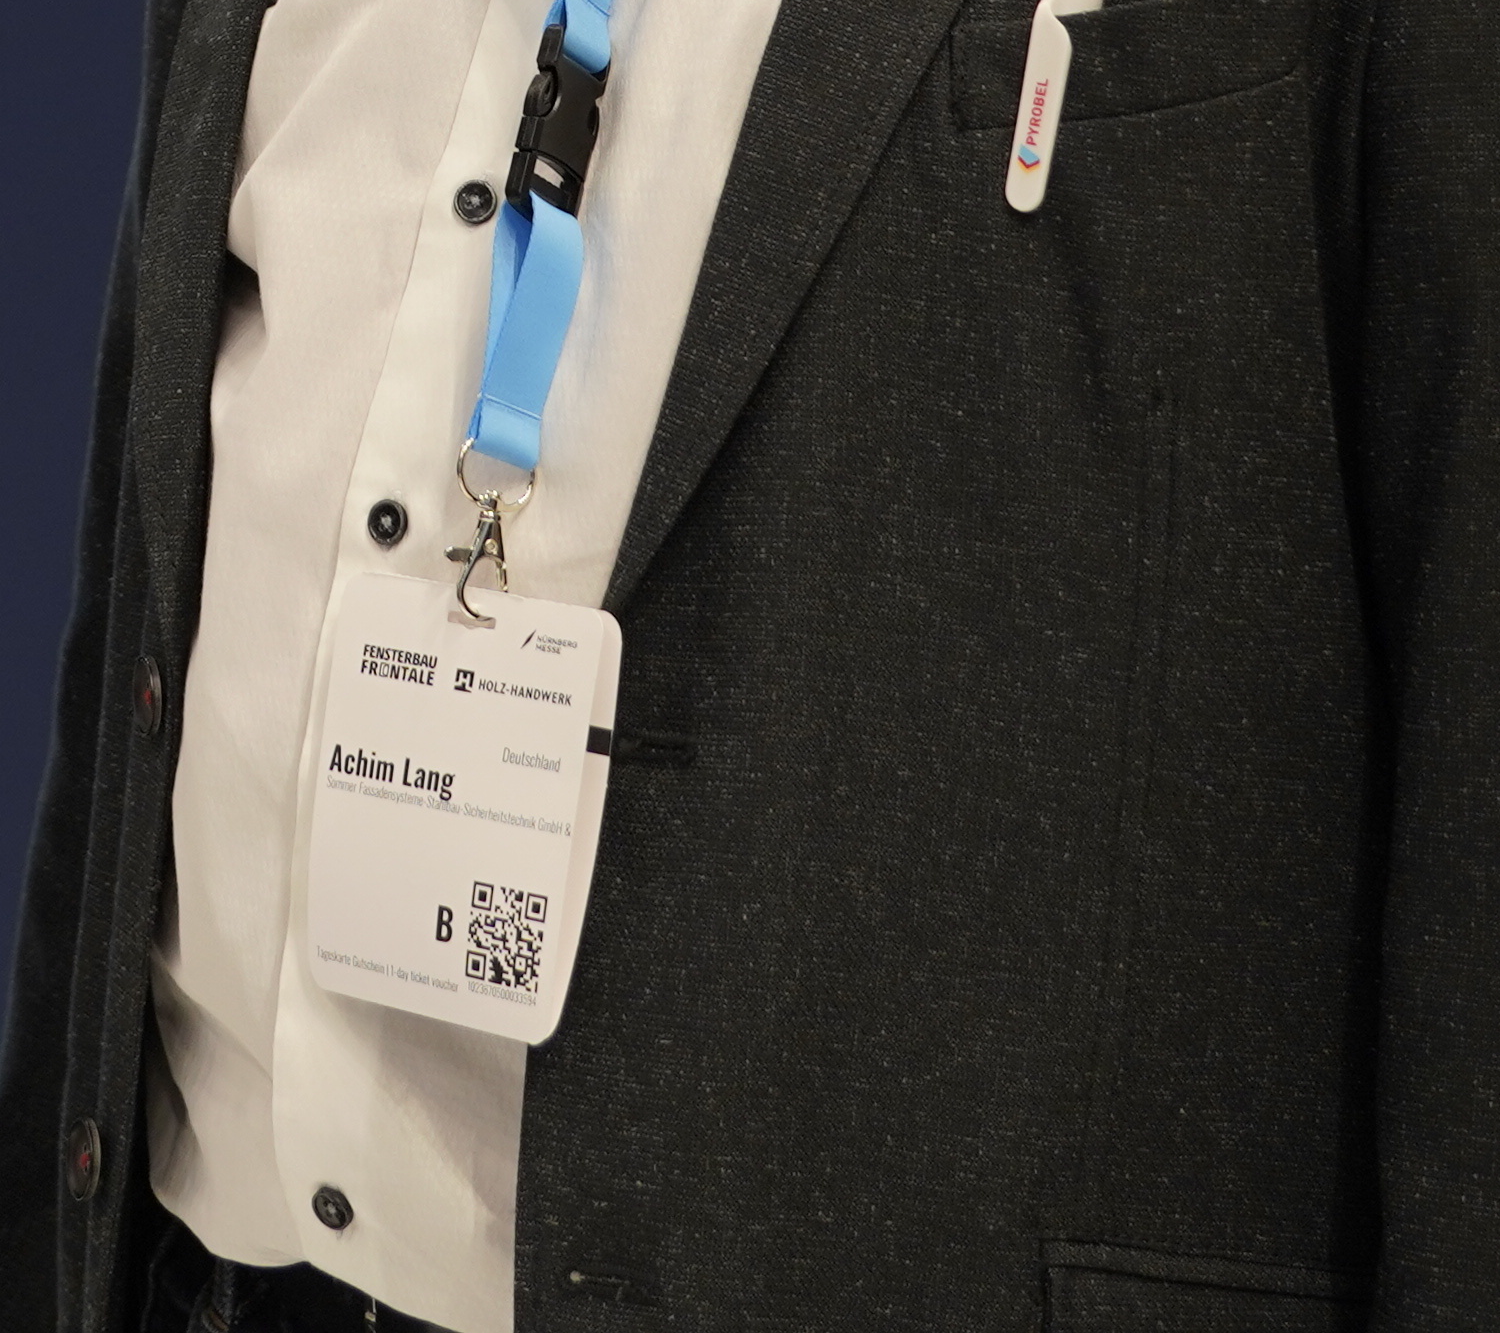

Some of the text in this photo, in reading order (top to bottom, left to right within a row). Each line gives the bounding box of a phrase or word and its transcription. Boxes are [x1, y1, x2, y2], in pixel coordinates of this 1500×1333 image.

[1026, 78, 1049, 146] PYROBEL
[535, 644, 561, 654] MESSE
[537, 634, 578, 649] NÜRNBERG
[363, 644, 438, 669] FENSTERBAU
[360, 659, 435, 686] FRONTALE
[478, 679, 572, 706] HOLZ-HANDWERK
[329, 744, 455, 801] Achim Lang
[502, 747, 561, 772] Deutschland
[538, 818, 563, 834] GmbH
[565, 826, 571, 836] &
[436, 905, 453, 942] B
[317, 945, 458, 992] Tageskarte Gutschein 1-day ticket voucher
